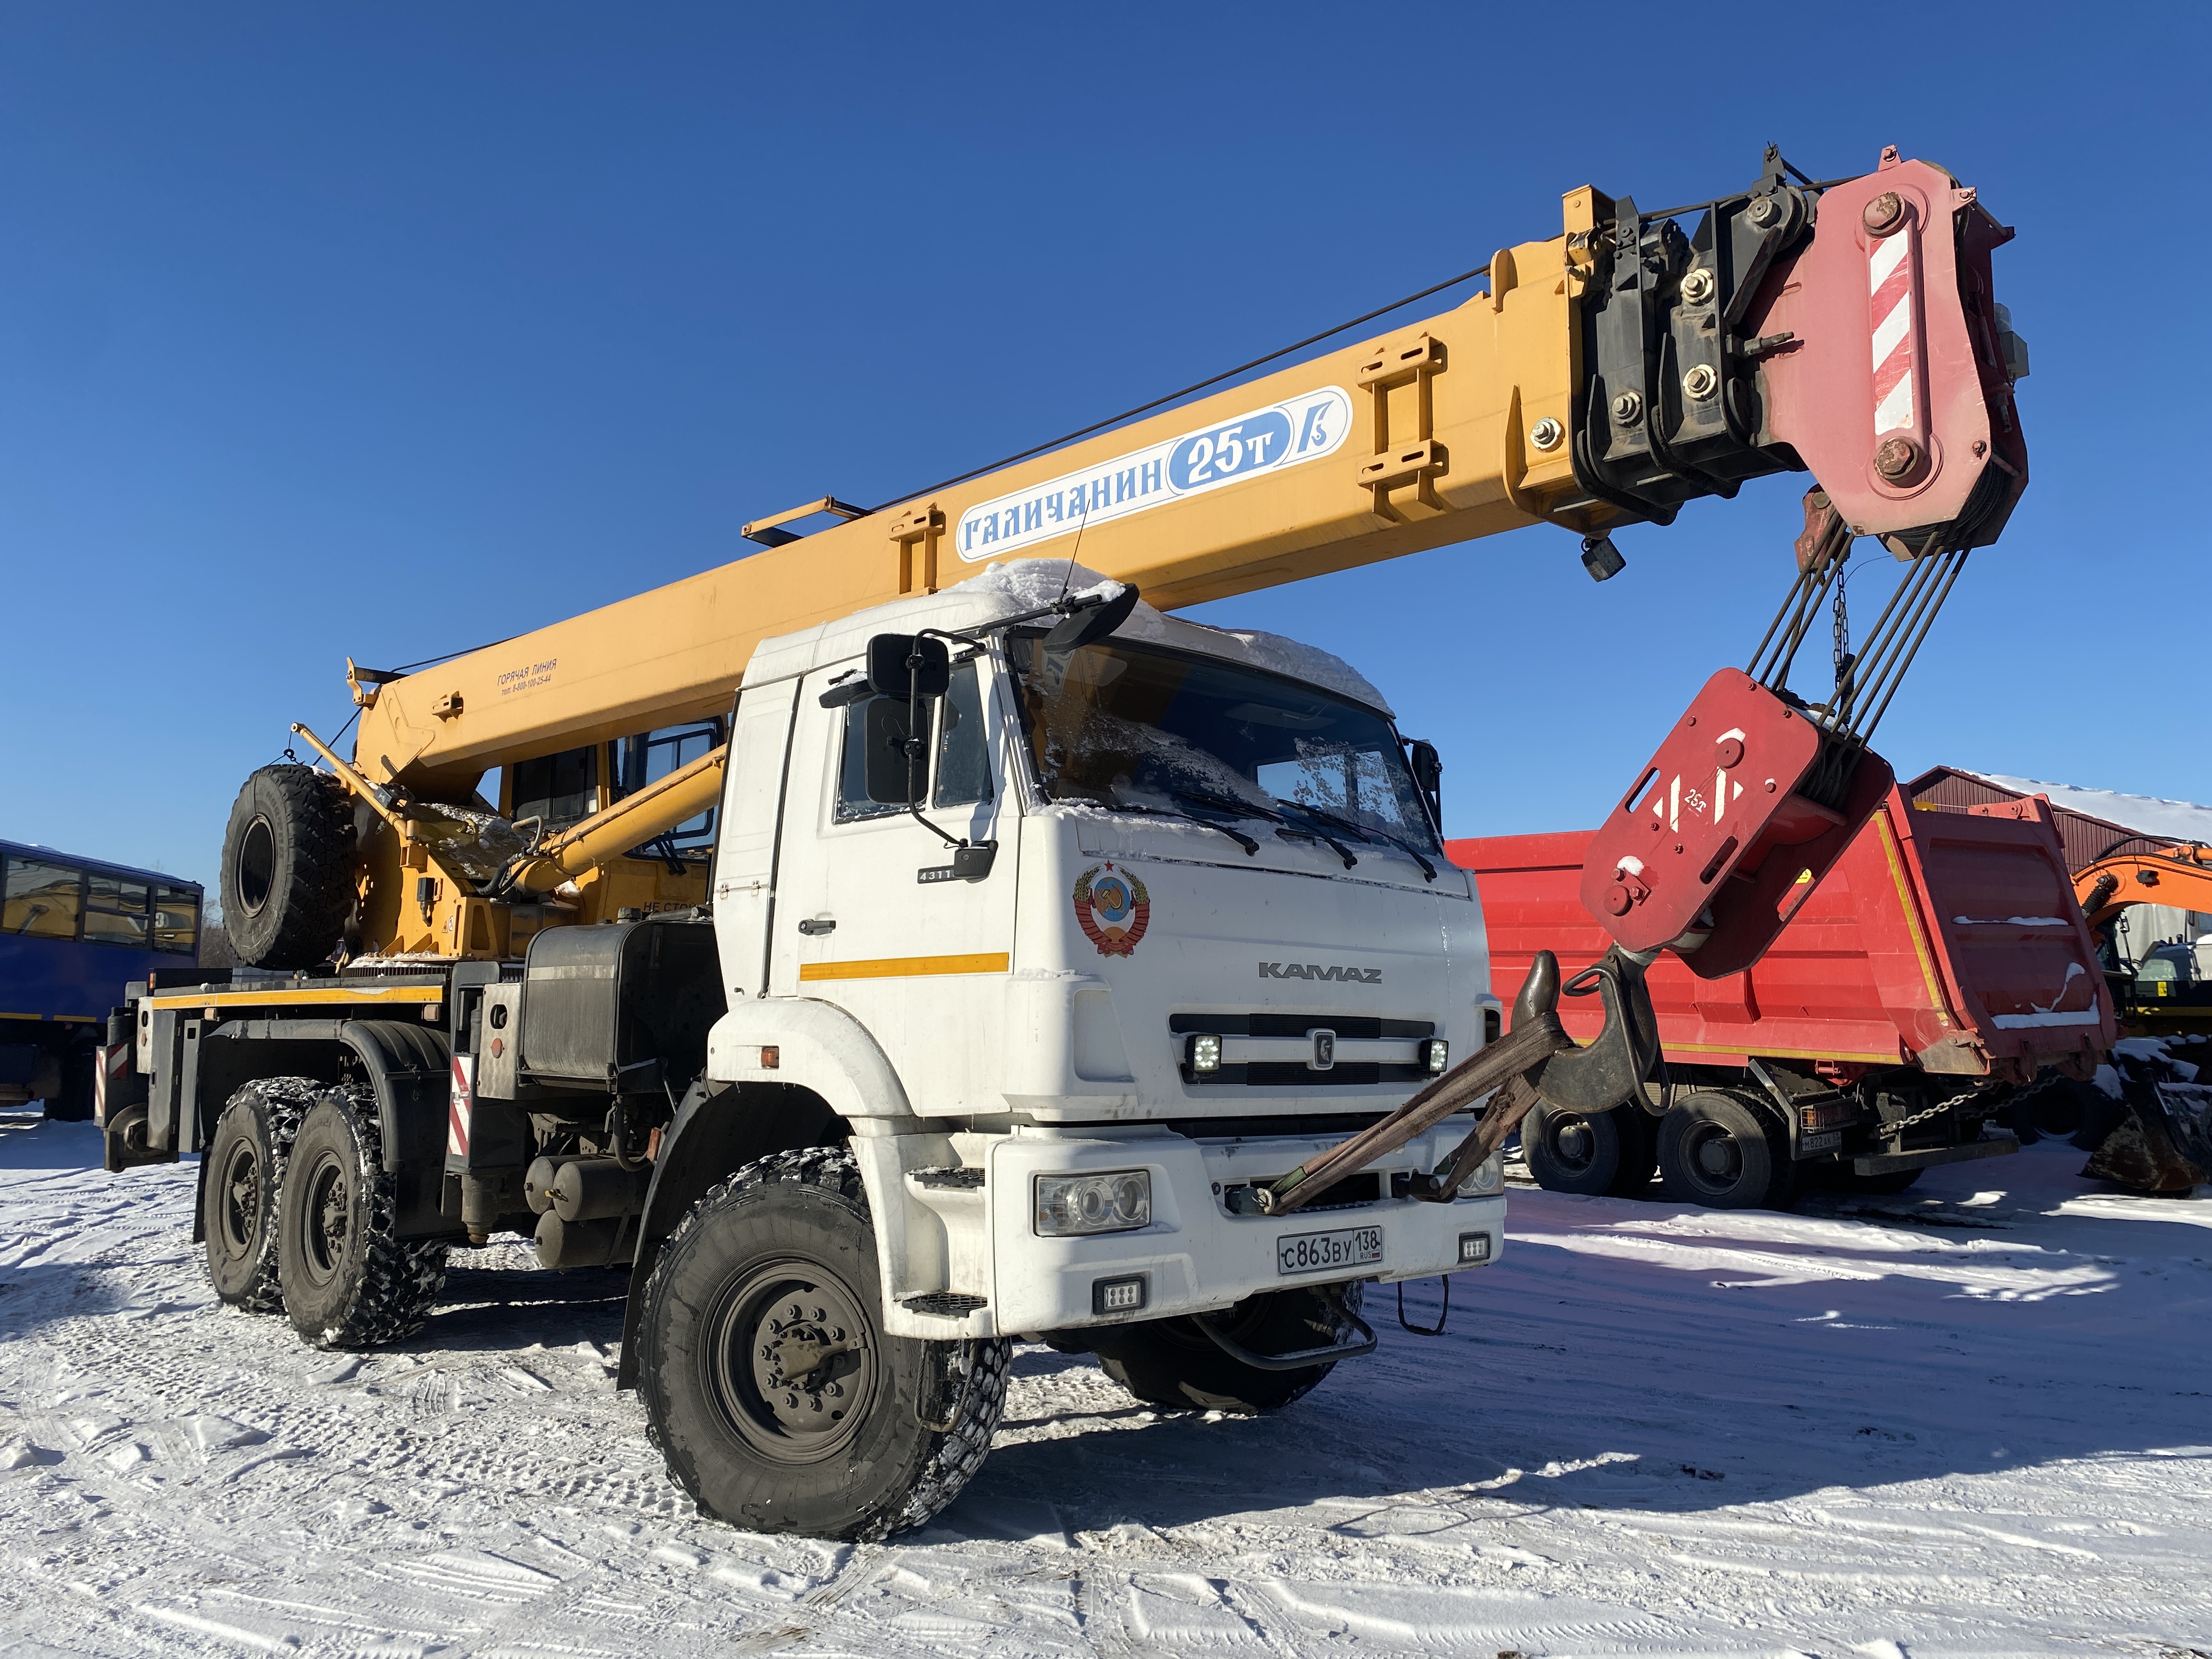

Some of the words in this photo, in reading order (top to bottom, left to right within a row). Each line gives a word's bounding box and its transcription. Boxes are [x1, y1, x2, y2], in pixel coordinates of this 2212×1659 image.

[965, 459, 1162, 550] ГАЛИЧАНИН
[497, 667, 529, 686] ГОРЯЧАЯ
[532, 658, 557, 676] ЛИНИЯ
[512, 674, 551, 692] 8-800-100-25-44
[919, 870, 955, 881] 4311
[644, 901, 661, 912] НЕ
[1259, 962, 1382, 984] KAMAZ
[1284, 1237, 1351, 1268] С863ВУ
[1355, 1230, 1377, 1251] 138
[1360, 1251, 1372, 1260] RUS
